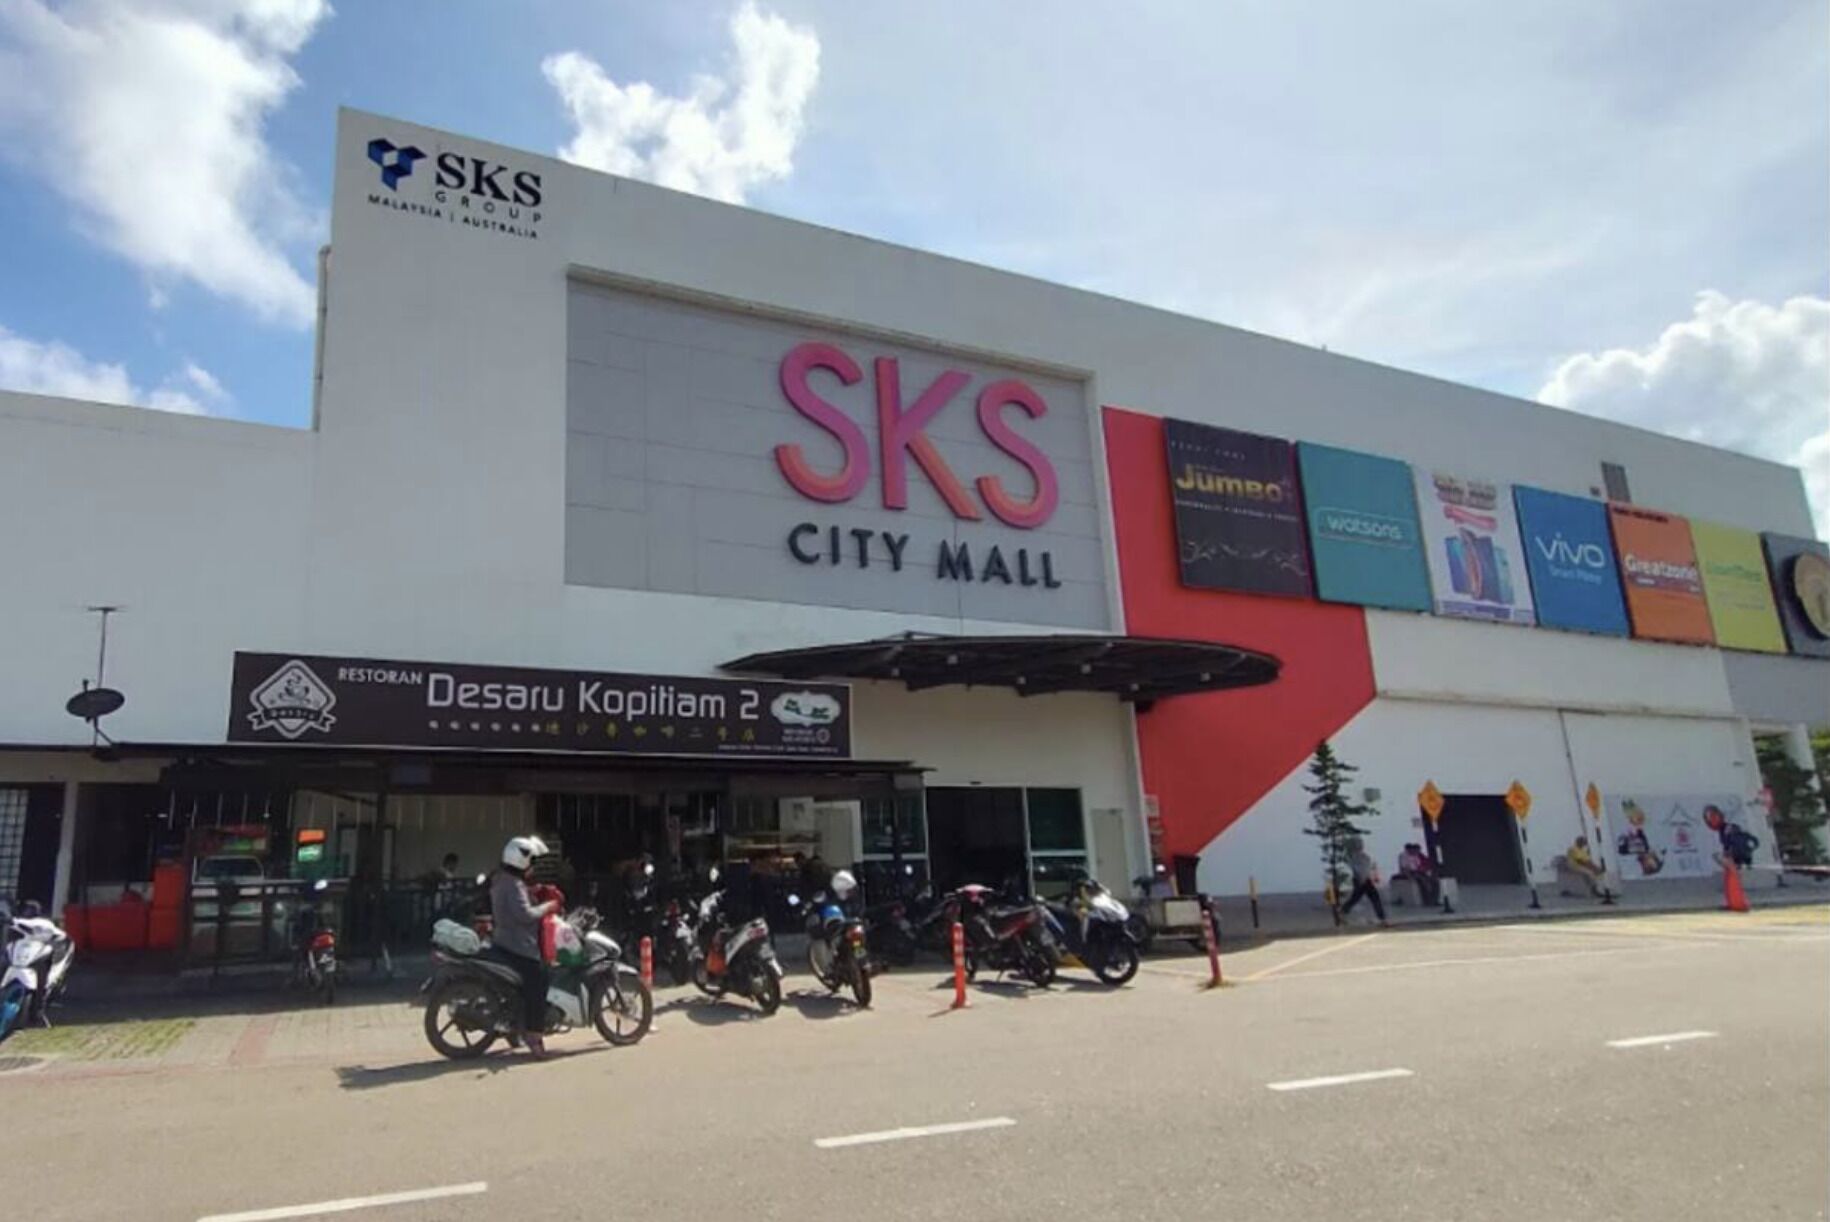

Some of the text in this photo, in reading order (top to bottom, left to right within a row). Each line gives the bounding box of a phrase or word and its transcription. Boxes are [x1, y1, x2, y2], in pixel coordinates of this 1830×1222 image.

[436, 153, 542, 207] SKS
[436, 191, 542, 223] GROUP
[368, 194, 538, 239] MALAYSIA AUSTRALIA
[774, 342, 1059, 530] SKS
[1327, 514, 1404, 540] watsons
[788, 523, 1062, 588] CITY MALL
[338, 666, 759, 721] RESTORAN Desaru Kopitiam 2
